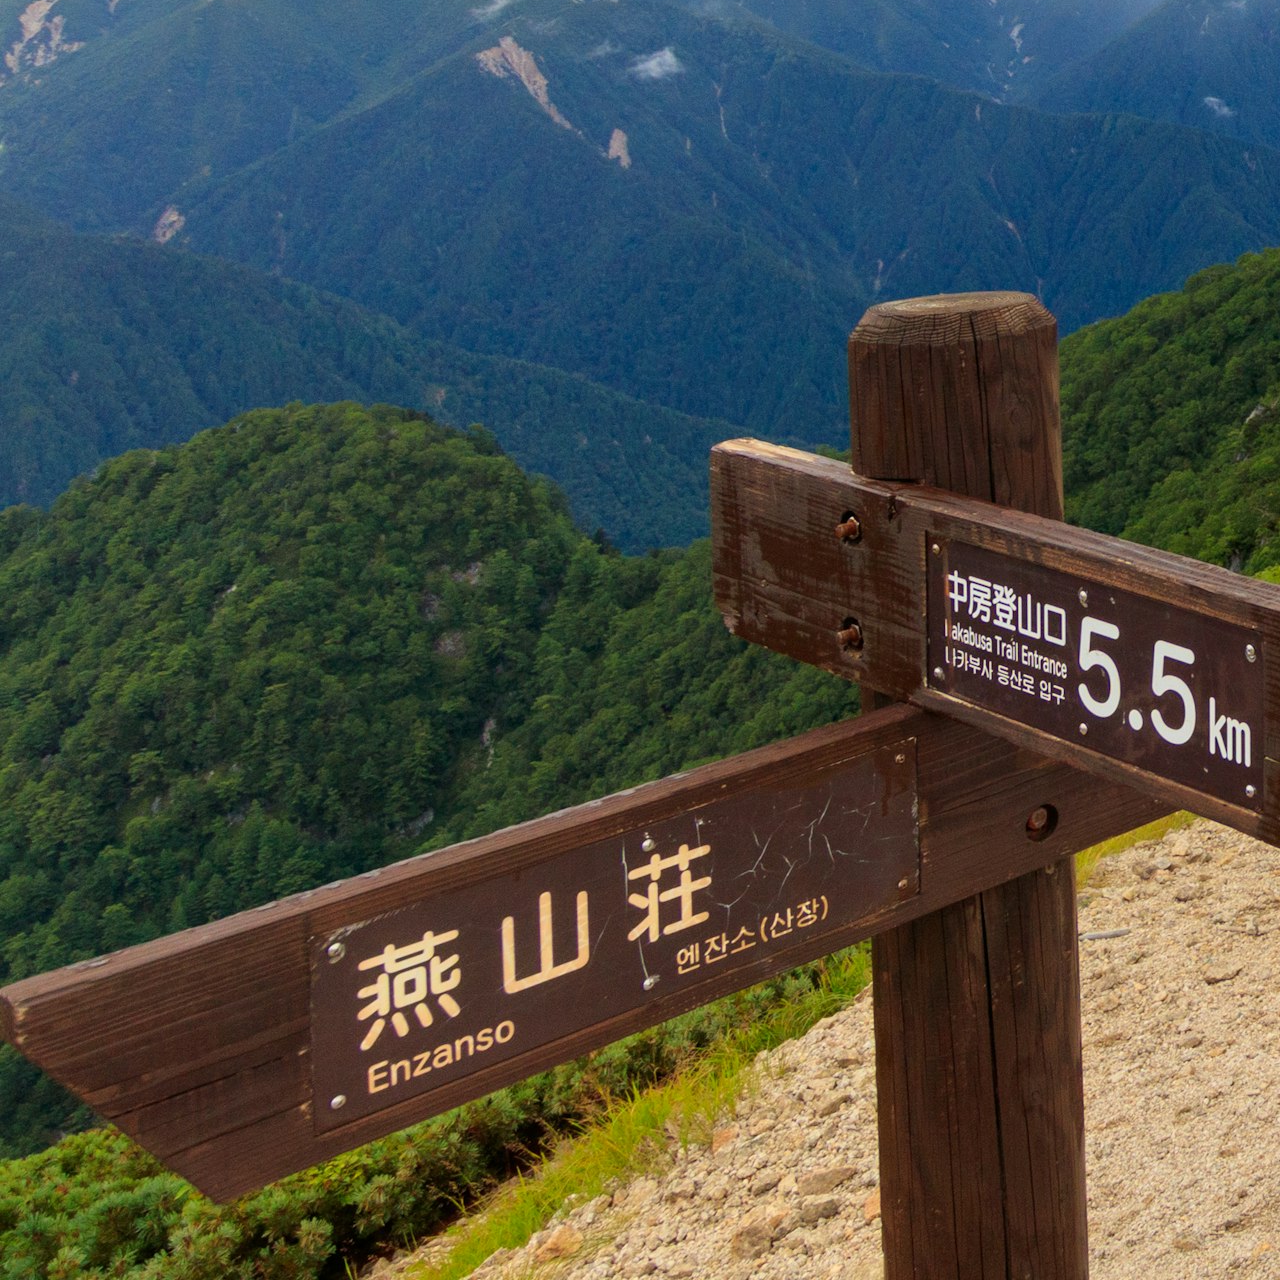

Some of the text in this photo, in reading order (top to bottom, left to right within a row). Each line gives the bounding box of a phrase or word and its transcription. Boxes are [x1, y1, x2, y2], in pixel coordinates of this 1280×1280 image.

[948, 570, 1066, 646] 中房登山口
[994, 635, 1019, 662] Trail
[1021, 644, 1067, 679] Entrance
[997, 665, 1035, 695] 등산로
[1040, 680, 1066, 705] 입구
[1078, 616, 1252, 768] 5.5 km
[357, 843, 711, 1051] 燕山荘
[676, 895, 829, 975] 엔잔소(산장)
[367, 1019, 515, 1095] Enzanso
